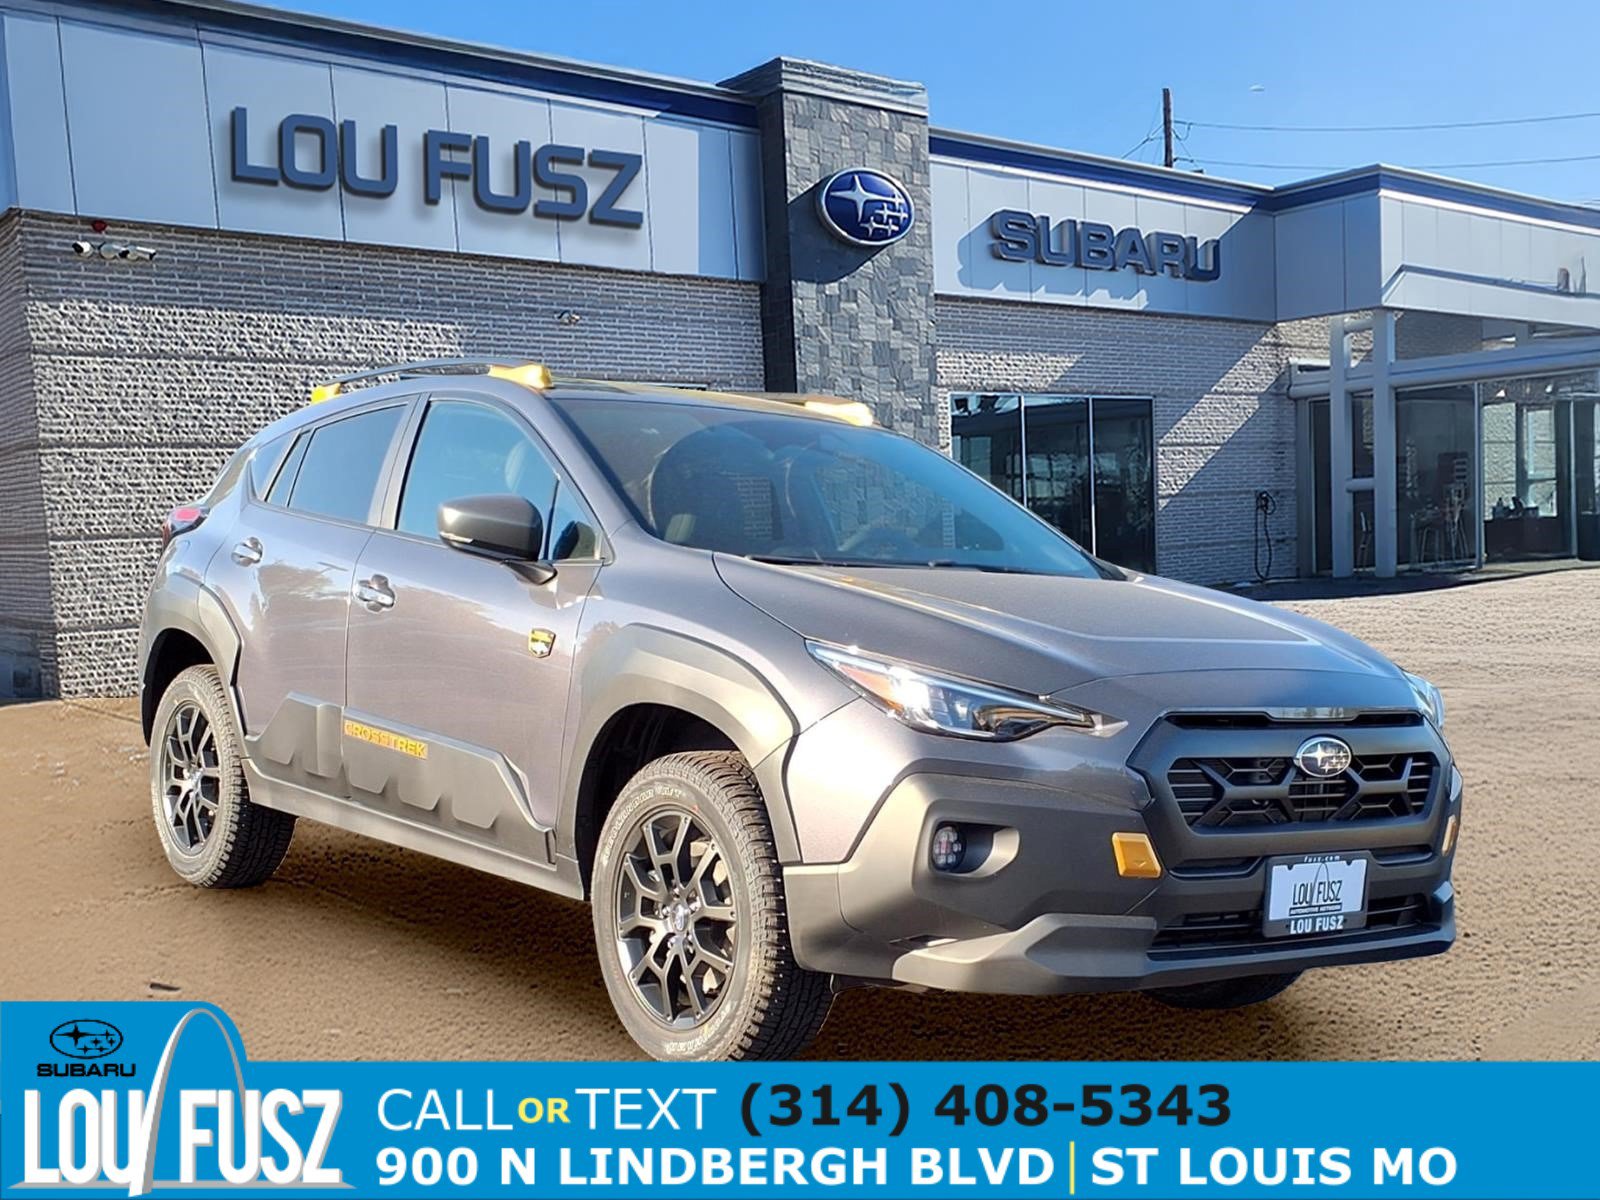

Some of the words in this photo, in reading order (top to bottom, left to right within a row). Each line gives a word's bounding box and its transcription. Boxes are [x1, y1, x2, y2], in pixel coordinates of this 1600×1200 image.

[231, 106, 398, 197] LOU
[424, 129, 644, 229] FUSZ
[991, 208, 1221, 281] SUBARU
[344, 720, 426, 757] CROSSTREK
[1292, 882, 1314, 906] LOU
[1317, 880, 1342, 903] FUSZ
[1290, 918, 1313, 934] LOU
[1315, 915, 1344, 931] FUSZ
